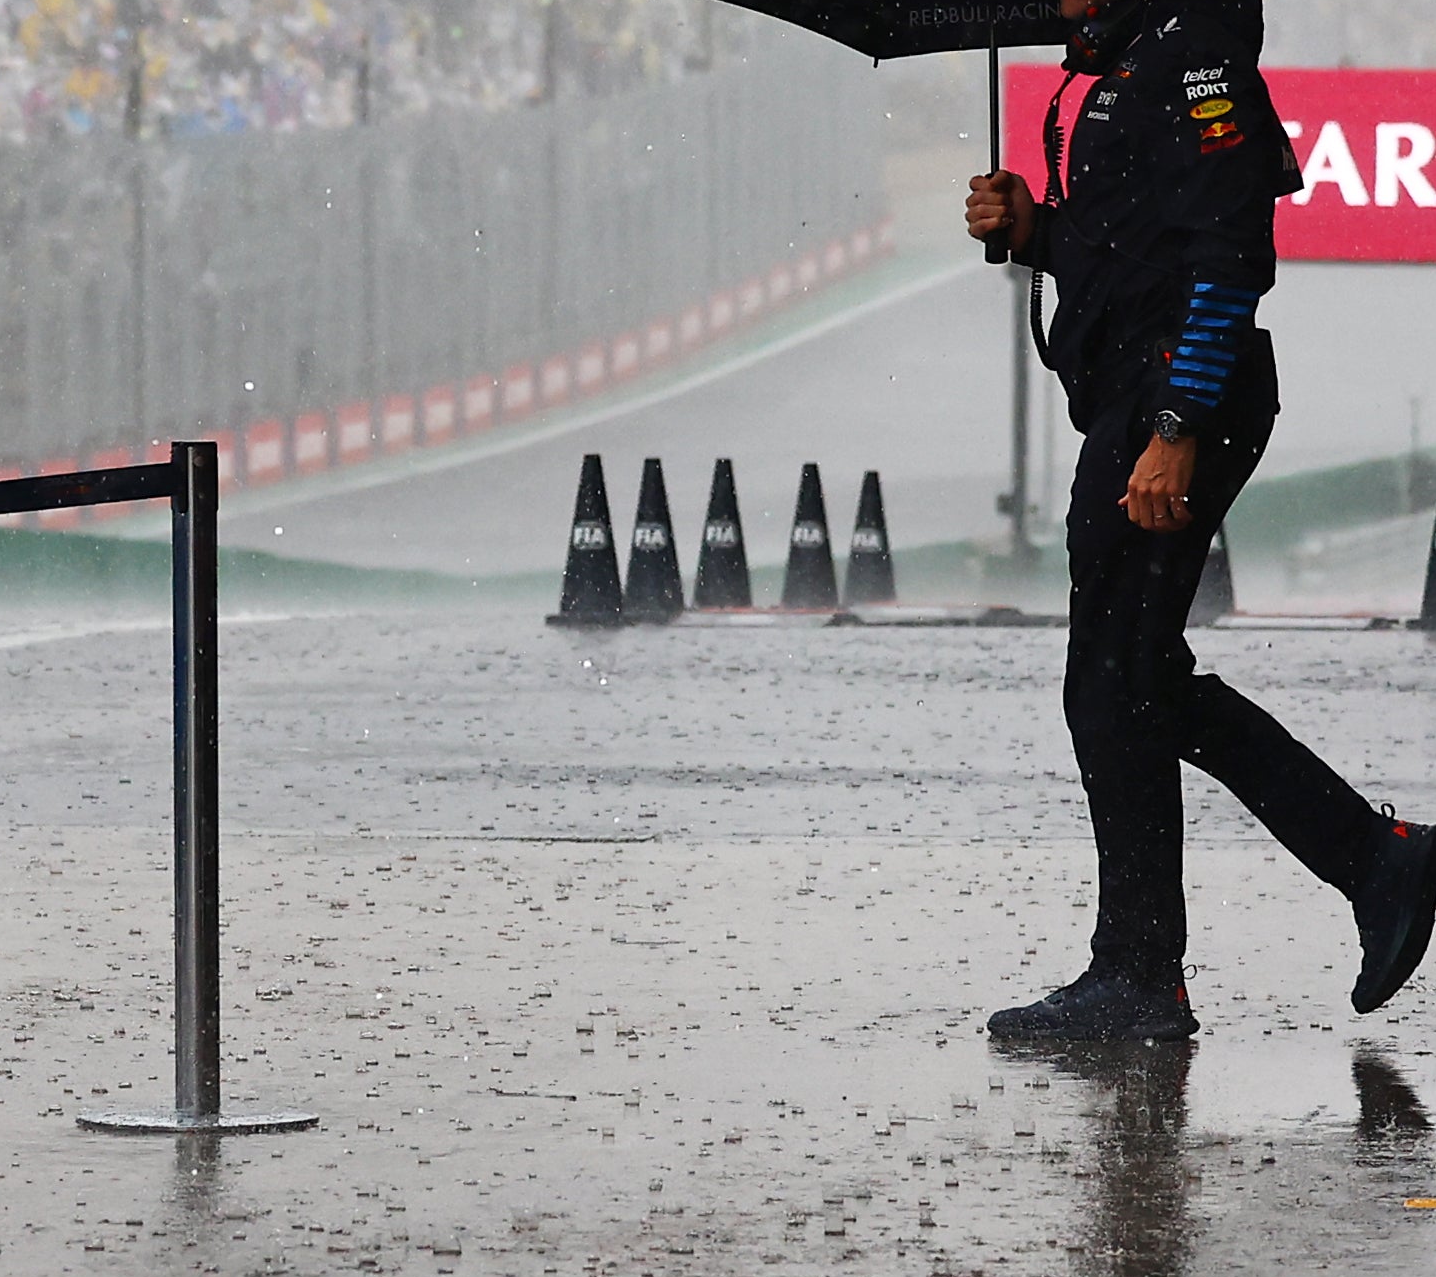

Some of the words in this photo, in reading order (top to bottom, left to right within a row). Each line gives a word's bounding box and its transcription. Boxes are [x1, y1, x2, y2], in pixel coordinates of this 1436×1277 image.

[909, 2, 1062, 28] REDBULLRACIN
[1182, 67, 1224, 84] telcel
[1185, 82, 1229, 101] ROKT
[573, 527, 606, 545] FIA
[634, 528, 667, 546] FIA
[706, 525, 735, 543] FIA
[794, 527, 823, 543] FIA
[853, 533, 880, 548] FIA
